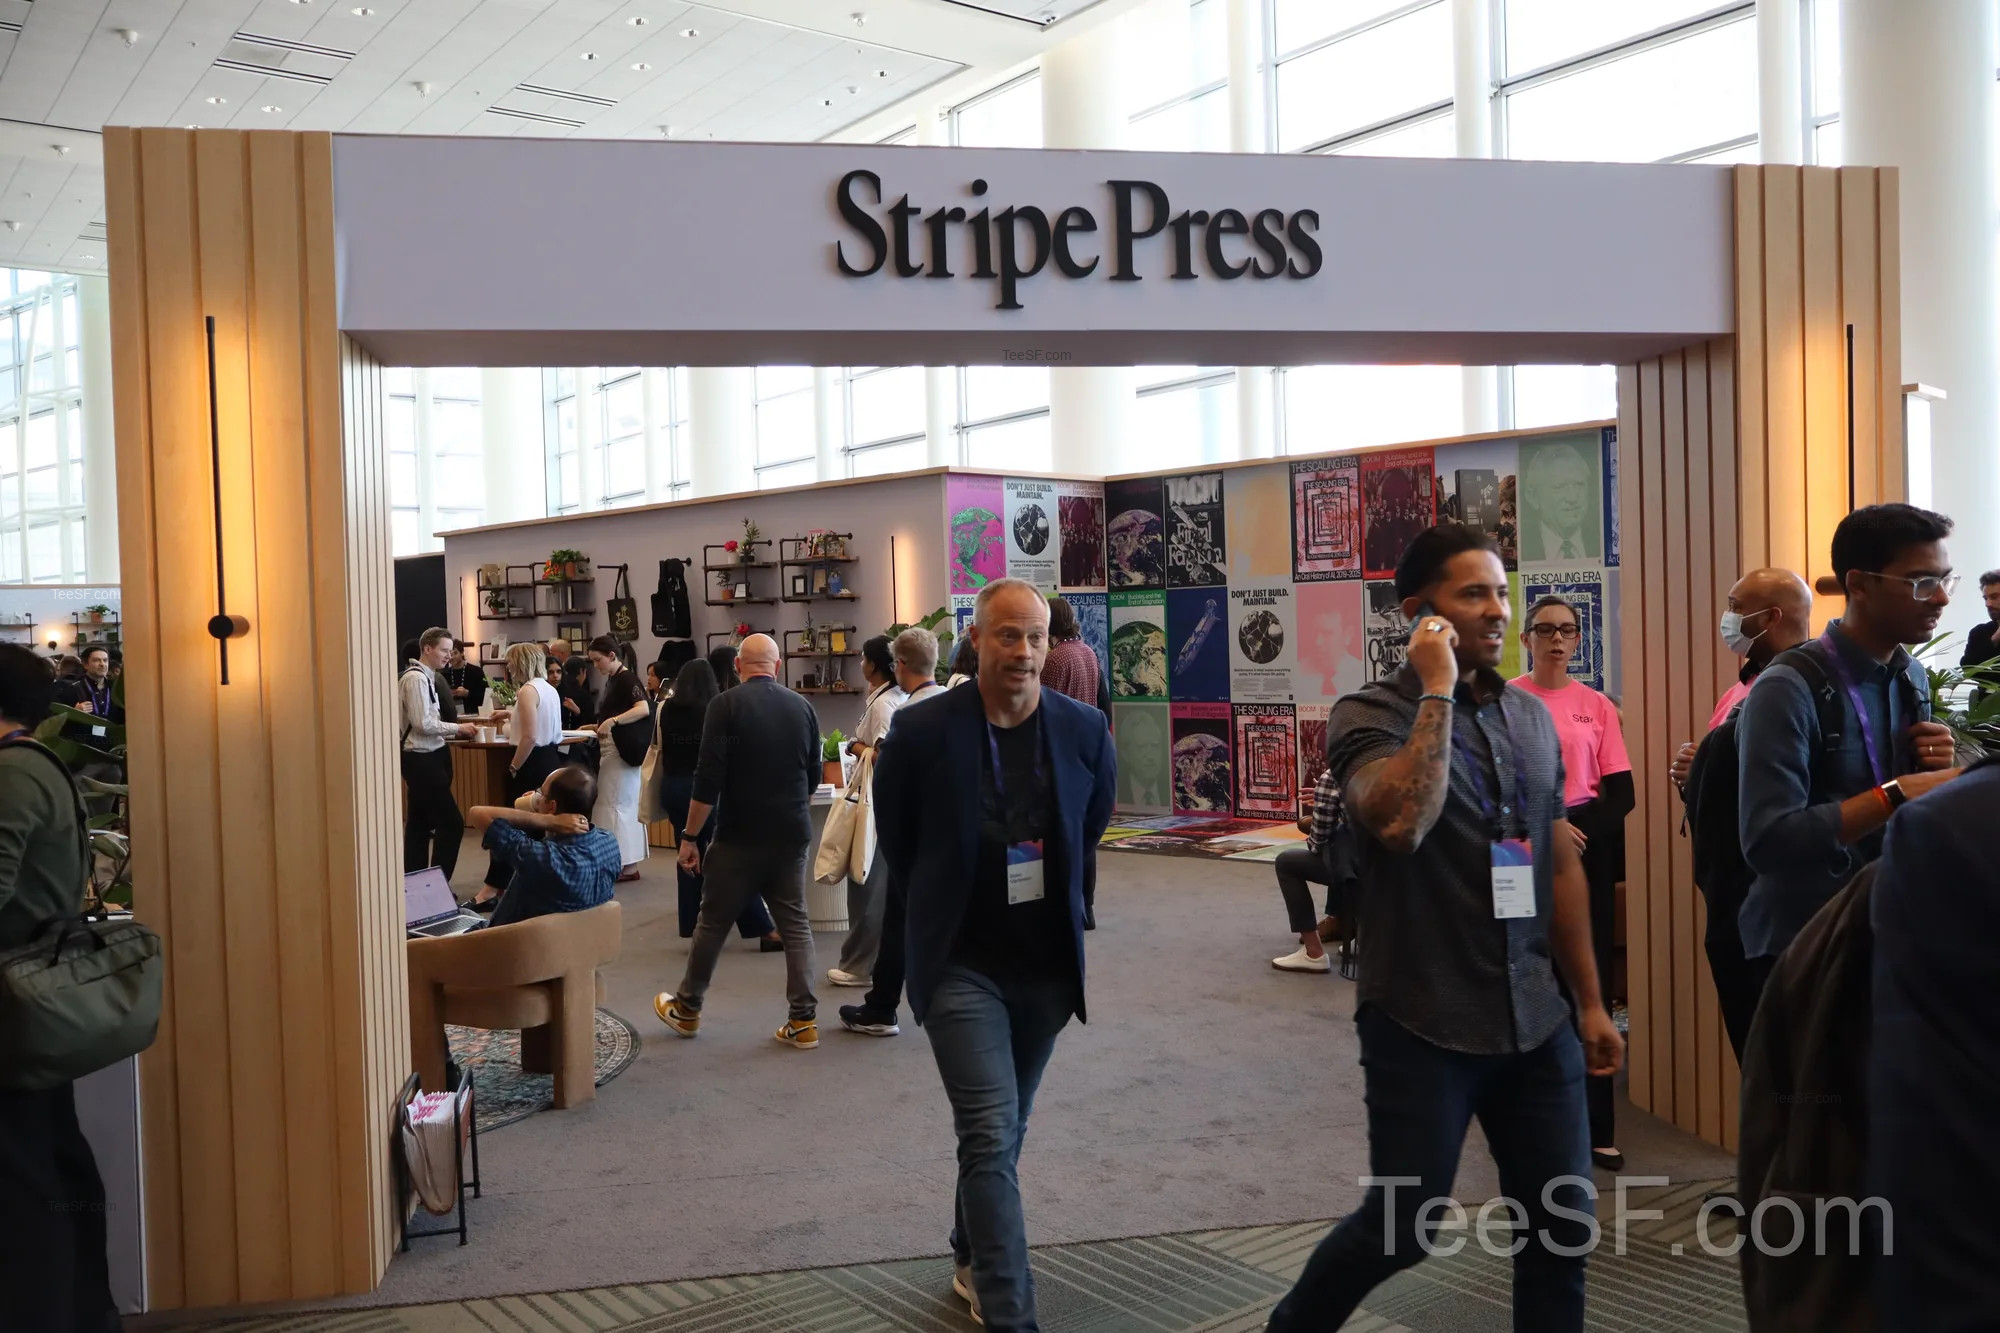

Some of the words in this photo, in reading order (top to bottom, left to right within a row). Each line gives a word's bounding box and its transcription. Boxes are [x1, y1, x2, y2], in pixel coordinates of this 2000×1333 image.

[836, 169, 1100, 309] Stripe
[1106, 180, 1323, 281] Press
[1291, 463, 1306, 474] THE
[1306, 458, 1341, 472] SCALING
[1341, 457, 1358, 468] ERA
[1304, 481, 1314, 489] THE
[1314, 480, 1337, 489] SCALING
[1521, 574, 1539, 585] THE
[1541, 571, 1581, 584] SCALING
[1582, 570, 1602, 583] ERA
[1231, 590, 1252, 599] DON'T
[1252, 589, 1267, 598] JUST
[1267, 588, 1289, 597] BUILD.
[953, 597, 966, 607] THE
[1072, 595, 1095, 605] SCALING
[1243, 597, 1278, 606] MAINTAIN.
[1233, 705, 1248, 715] THE
[1248, 705, 1279, 716] SCALING
[1279, 705, 1295, 716] ERA
